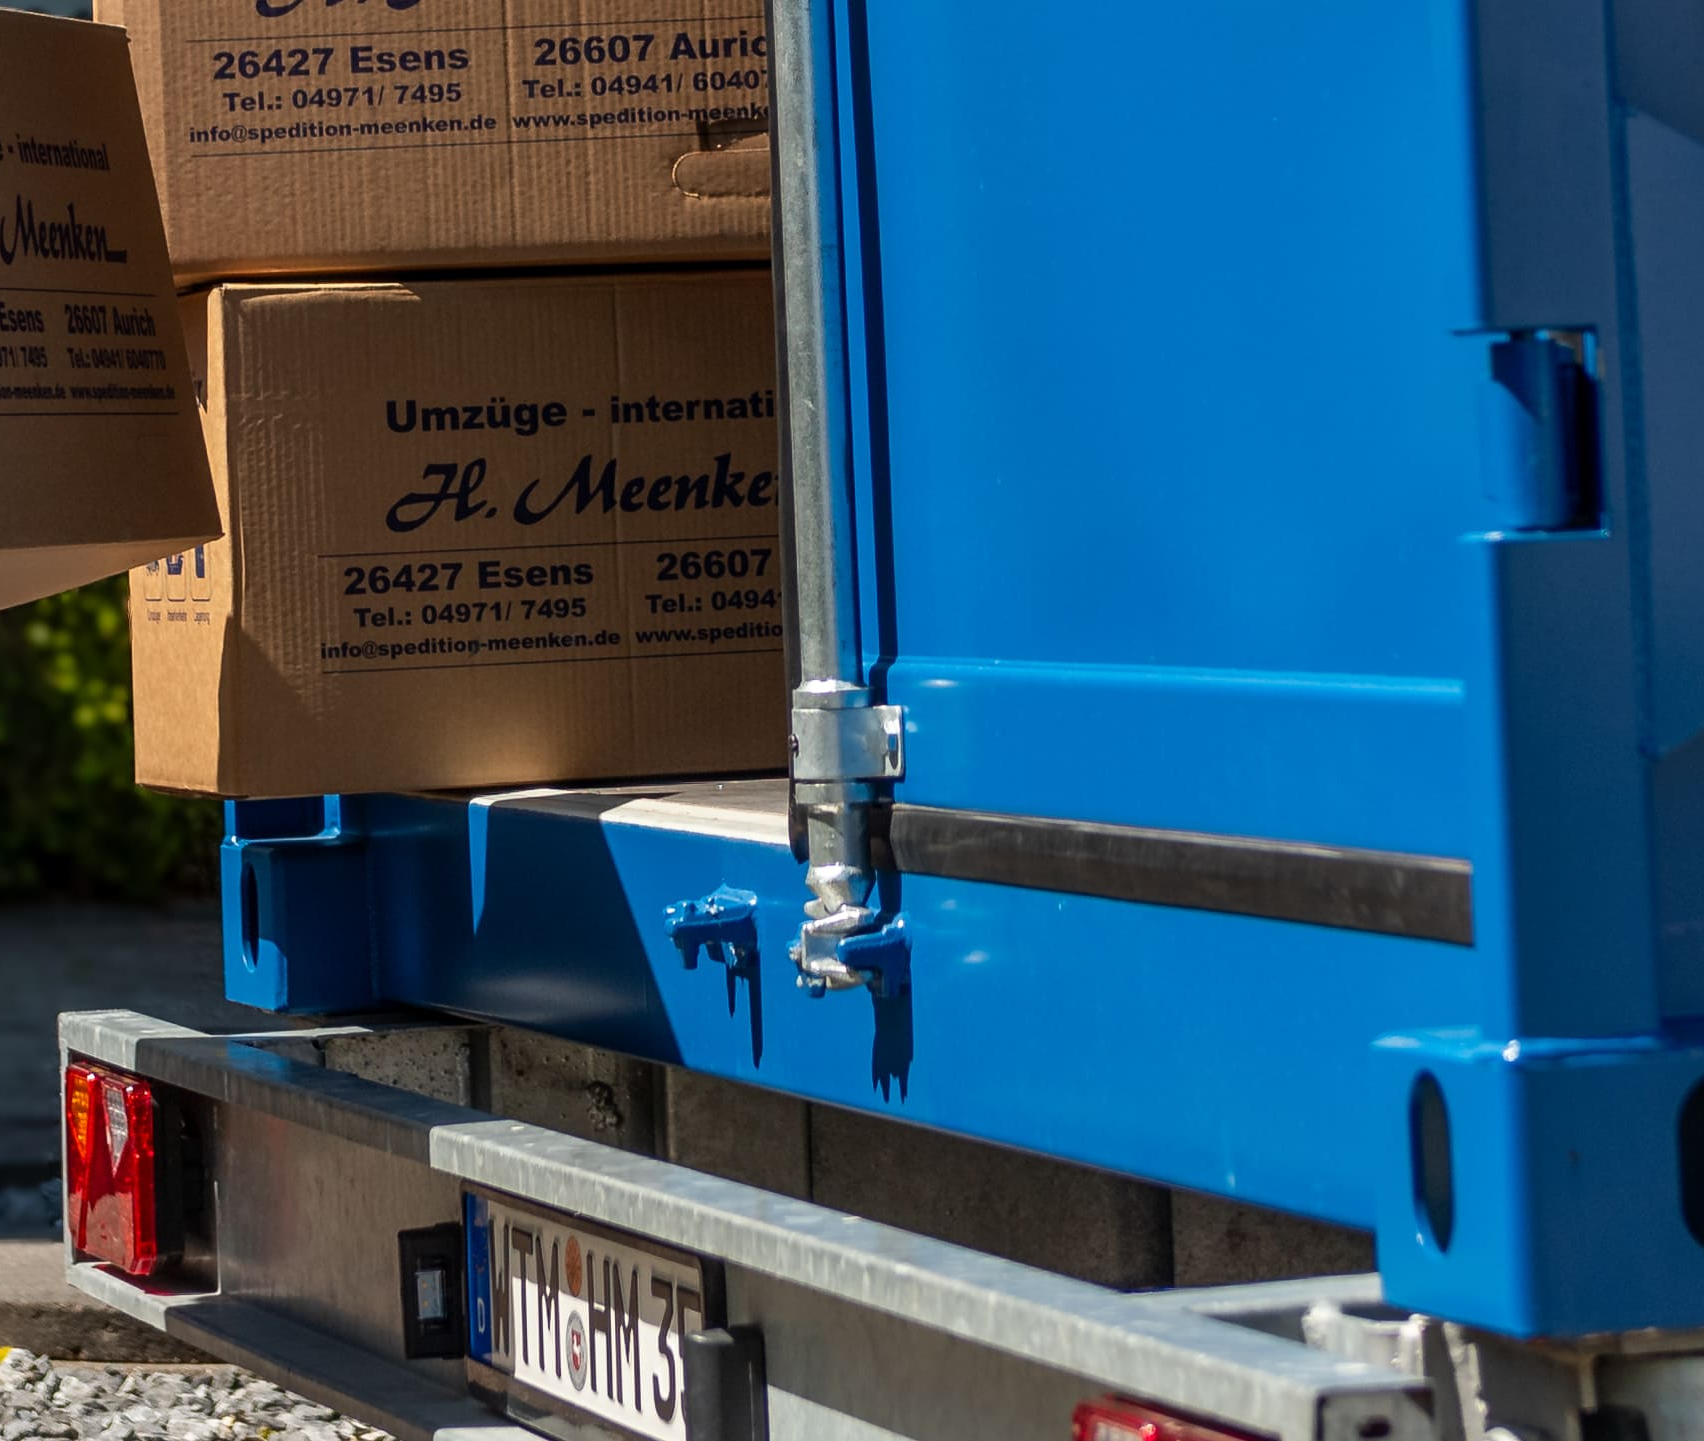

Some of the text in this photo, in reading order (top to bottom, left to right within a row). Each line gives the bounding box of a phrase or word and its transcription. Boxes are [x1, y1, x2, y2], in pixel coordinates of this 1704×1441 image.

[212, 44, 470, 80] 26427 Esens
[533, 34, 654, 66] 26607
[223, 82, 462, 112] Tel.: 04971/ 7495
[522, 78, 583, 100] Tel.:
[590, 70, 683, 98] 04941/
[189, 115, 497, 144] info@spedition-meenken.de
[17, 134, 110, 171] international
[0, 194, 127, 265] Meenken
[64, 303, 156, 337] 26607 Aurich
[385, 396, 568, 437] Umzüge
[385, 452, 778, 532] H. Meenke
[343, 561, 595, 595] 26427 Esens
[656, 550, 772, 582] 26607
[354, 598, 588, 628] Tel.: 04971/ 7495
[646, 587, 782, 614] Tel.: 0494
[320, 629, 621, 661] info@spedition-meenken.de
[586, 1250, 642, 1413] HM
